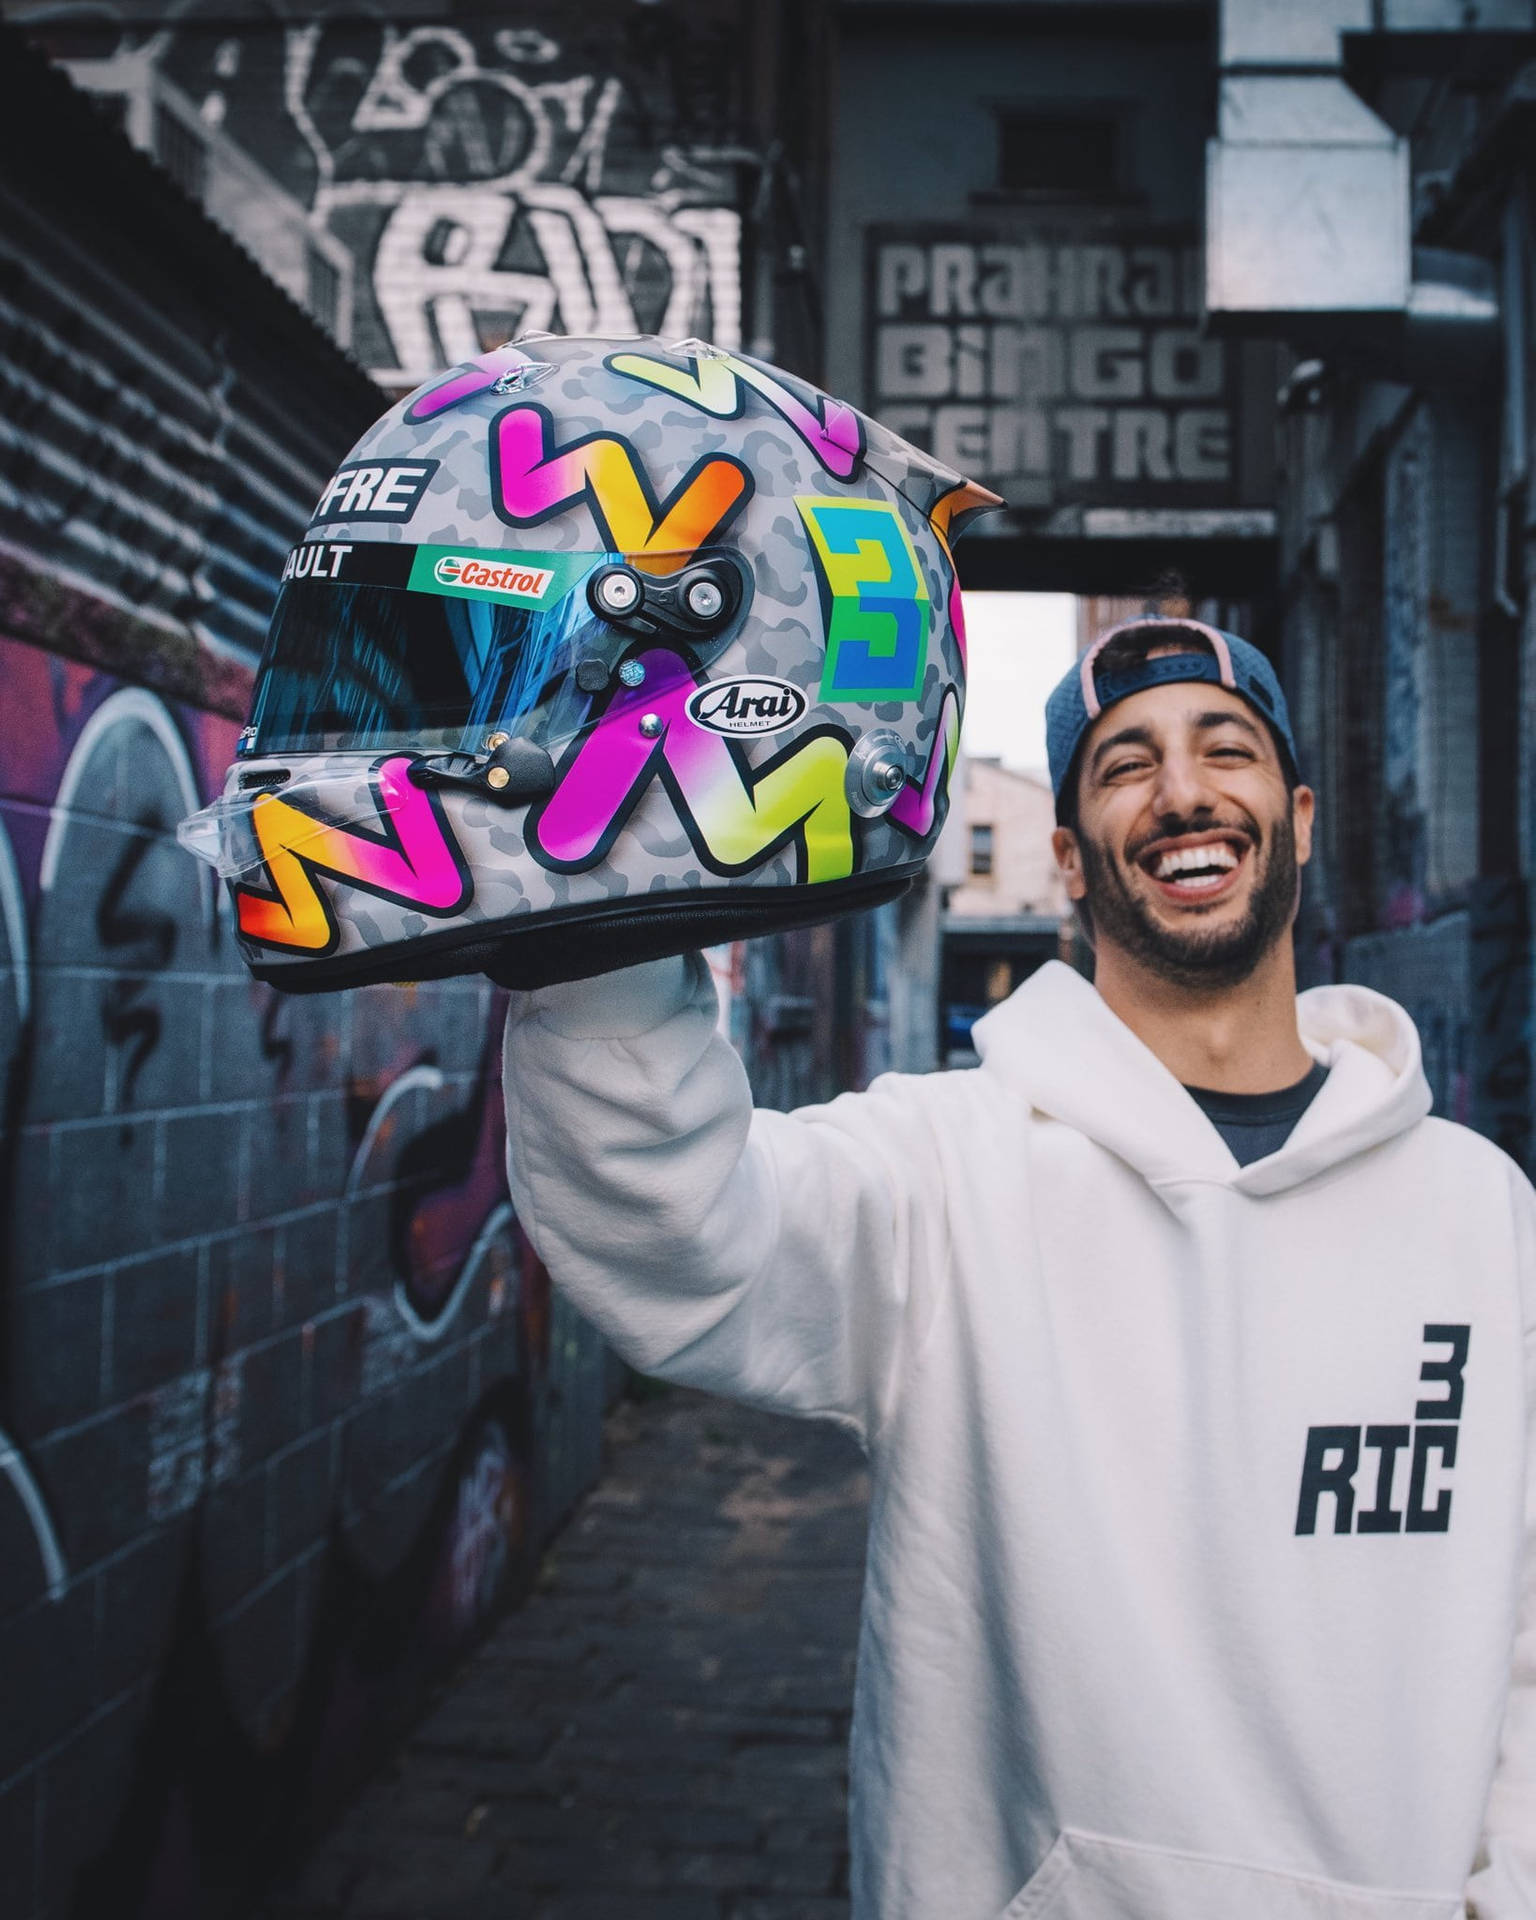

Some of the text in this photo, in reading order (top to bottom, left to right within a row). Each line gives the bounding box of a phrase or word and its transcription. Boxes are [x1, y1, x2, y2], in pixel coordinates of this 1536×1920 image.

[461, 562, 545, 594] Castrol
[811, 507, 921, 689] 3
[699, 686, 793, 720] Arai
[1415, 1324, 1471, 1419] 3
[1295, 1425, 1459, 1535] RIC
